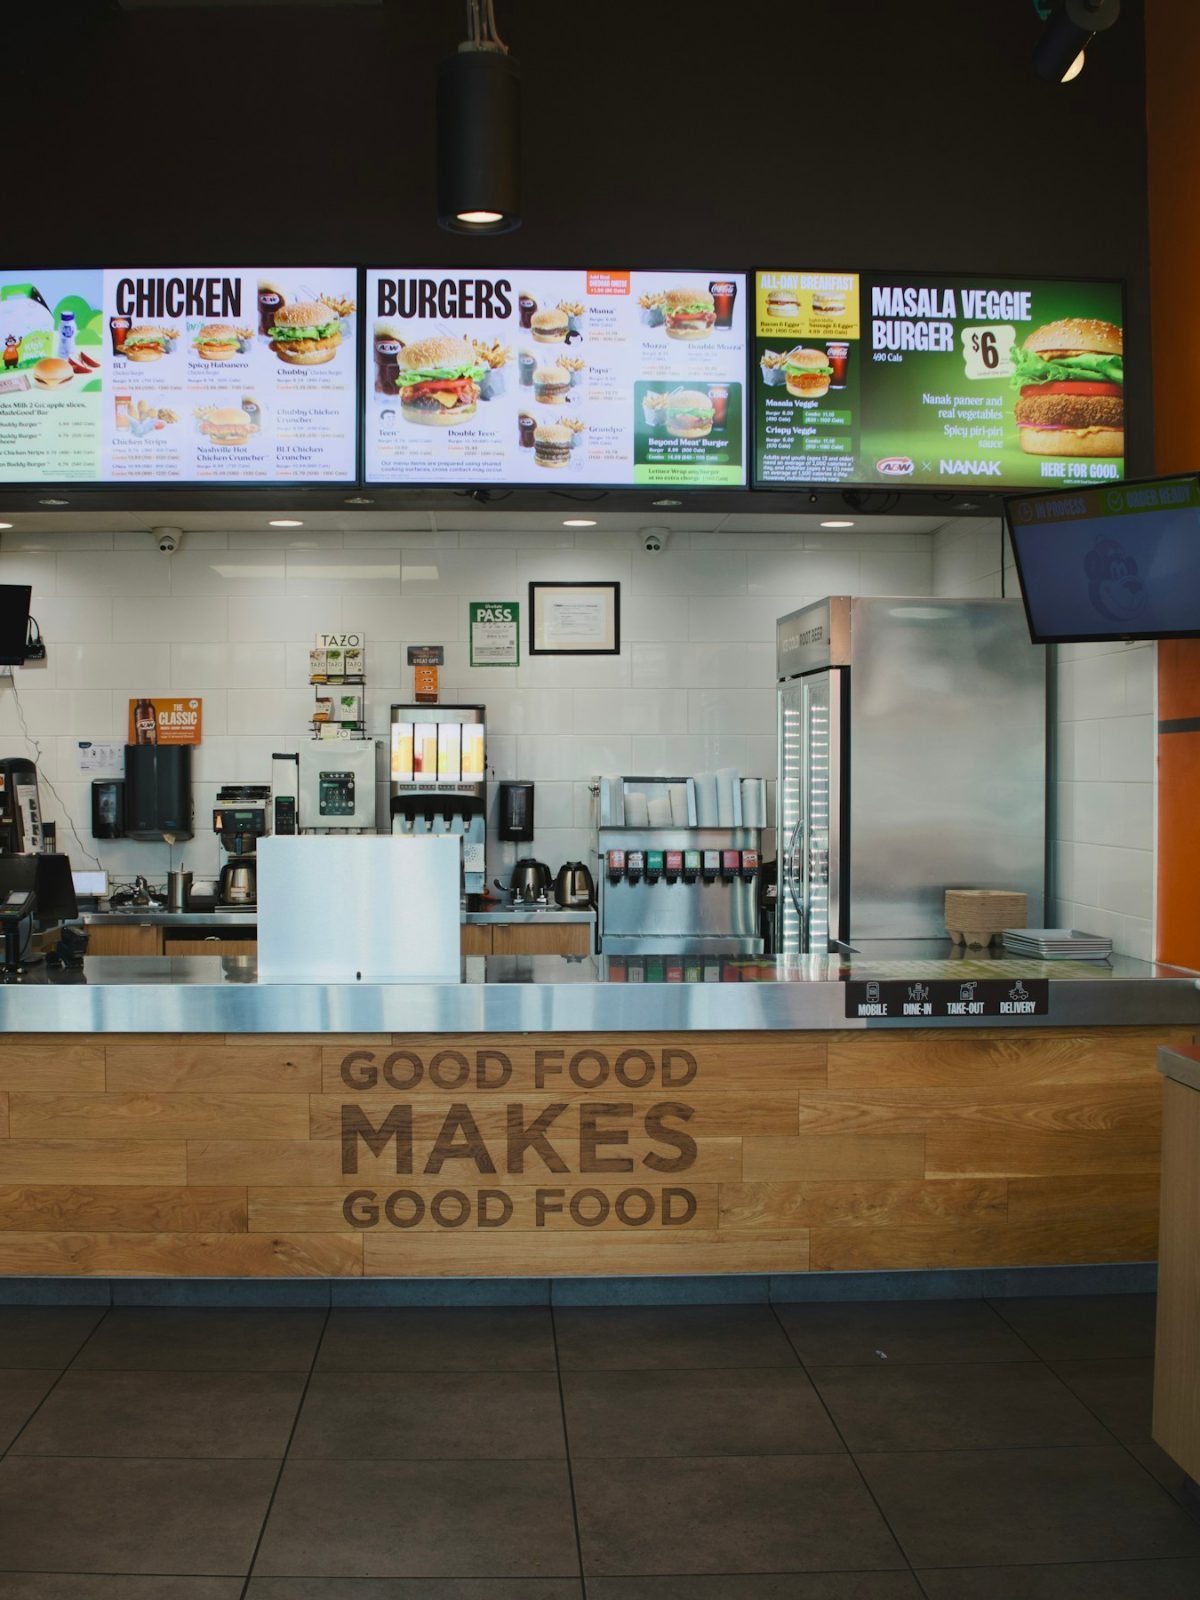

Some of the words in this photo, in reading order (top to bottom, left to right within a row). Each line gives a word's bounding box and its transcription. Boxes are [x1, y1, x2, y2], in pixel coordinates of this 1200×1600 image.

[800, 276, 853, 291] BREAKFAST
[116, 278, 241, 318] CHICKEN
[377, 278, 512, 319] BURGERS
[872, 286, 956, 318] MASALA
[961, 290, 1032, 321] VEGGIE
[872, 320, 954, 352] BURGER
[872, 352, 887, 362] 490
[887, 353, 903, 362] Cals
[971, 331, 999, 369] $6
[188, 362, 209, 370] Spicy
[277, 368, 308, 376] Chubby
[765, 399, 793, 407] Masala
[794, 400, 818, 409] Veggie
[922, 393, 951, 405] Nanak
[953, 396, 984, 408] paneer
[985, 395, 1002, 407] and
[938, 408, 955, 418] real
[957, 409, 1003, 421] vegetables
[765, 426, 792, 435] Crispy
[792, 427, 817, 435] Veggie
[943, 424, 969, 437] Spicy
[648, 438, 679, 447] Beyond
[702, 439, 728, 448] Burger
[978, 440, 1004, 449] sauce
[939, 459, 1001, 476] NANAK
[1040, 461, 1066, 478] HERE
[1068, 462, 1088, 478] FOR
[1089, 463, 1120, 479] GOOD.
[1046, 498, 1089, 517] PROCESS
[476, 608, 513, 622] PASS
[321, 634, 360, 647] TAZO
[173, 703, 183, 712] THE
[158, 711, 198, 726] CLASSIC
[858, 1003, 888, 1016] MOBILE
[903, 1002, 933, 1015] DINE-IN
[946, 1001, 984, 1015] TAKE-OUT
[999, 1001, 1036, 1014] DELIVERY
[340, 1050, 512, 1090] GOOD
[534, 1049, 698, 1089] FOOD
[341, 1101, 698, 1175] MAKES
[342, 1189, 513, 1228] GOOD
[535, 1187, 697, 1227] FOOD
